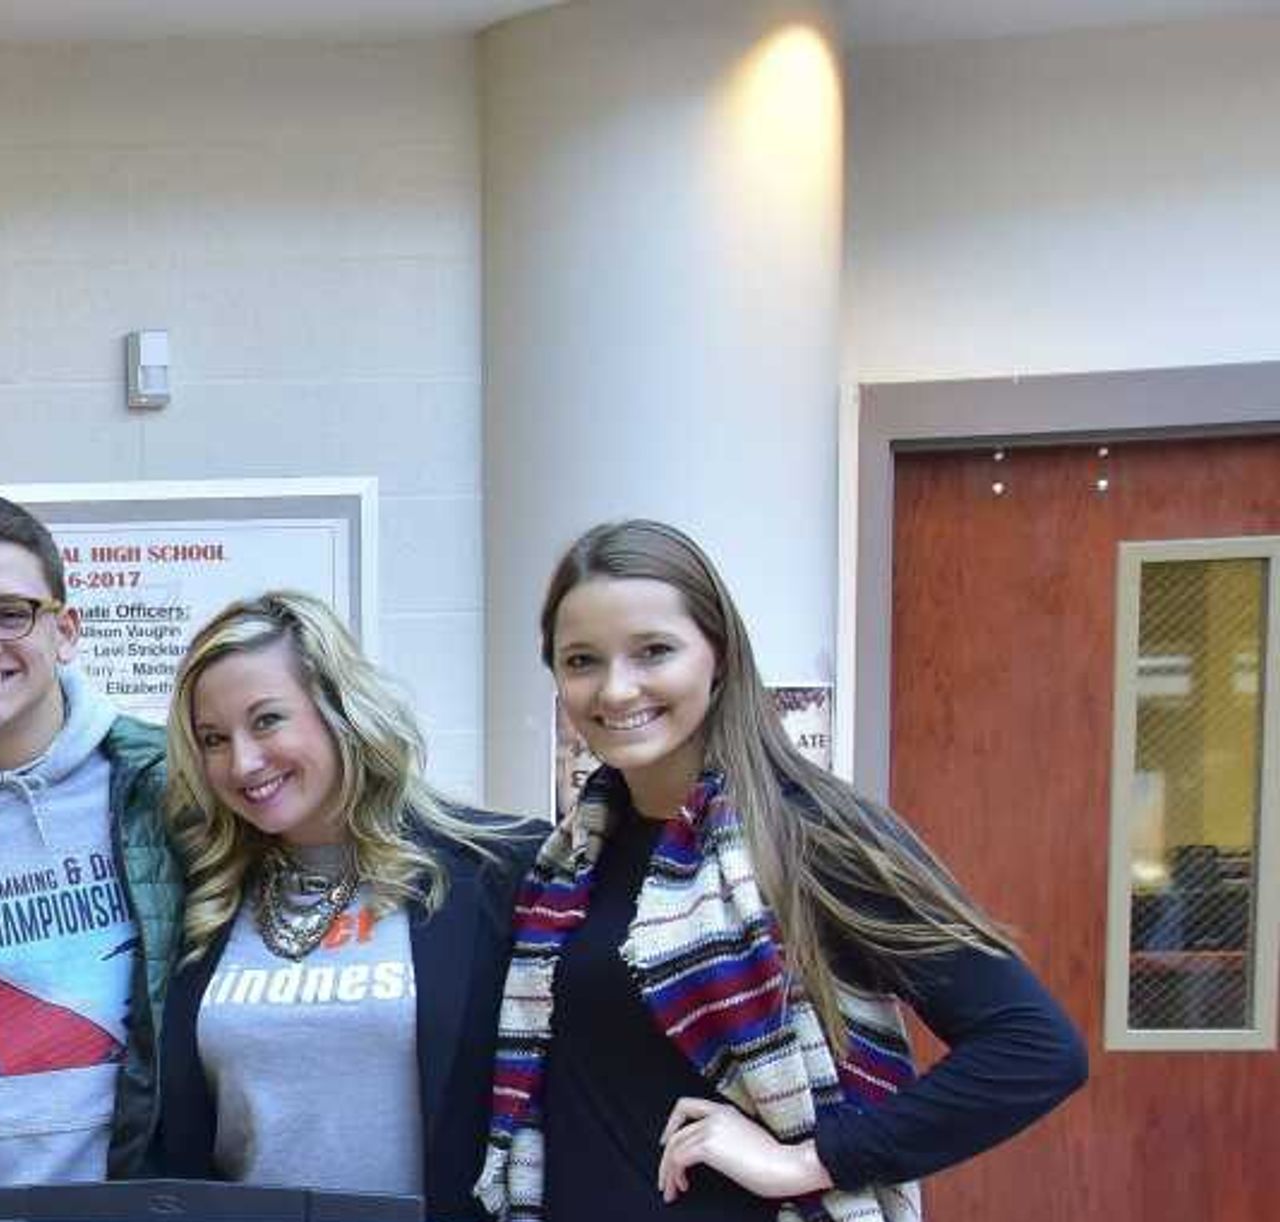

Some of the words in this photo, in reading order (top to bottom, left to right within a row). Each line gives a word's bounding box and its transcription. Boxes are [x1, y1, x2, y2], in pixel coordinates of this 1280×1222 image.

[91, 546, 141, 563] HIGH
[147, 544, 224, 562] SCHOOL
[125, 624, 182, 640] Vaughn
[62, 857, 82, 885] &
[203, 959, 417, 1004] indnes
